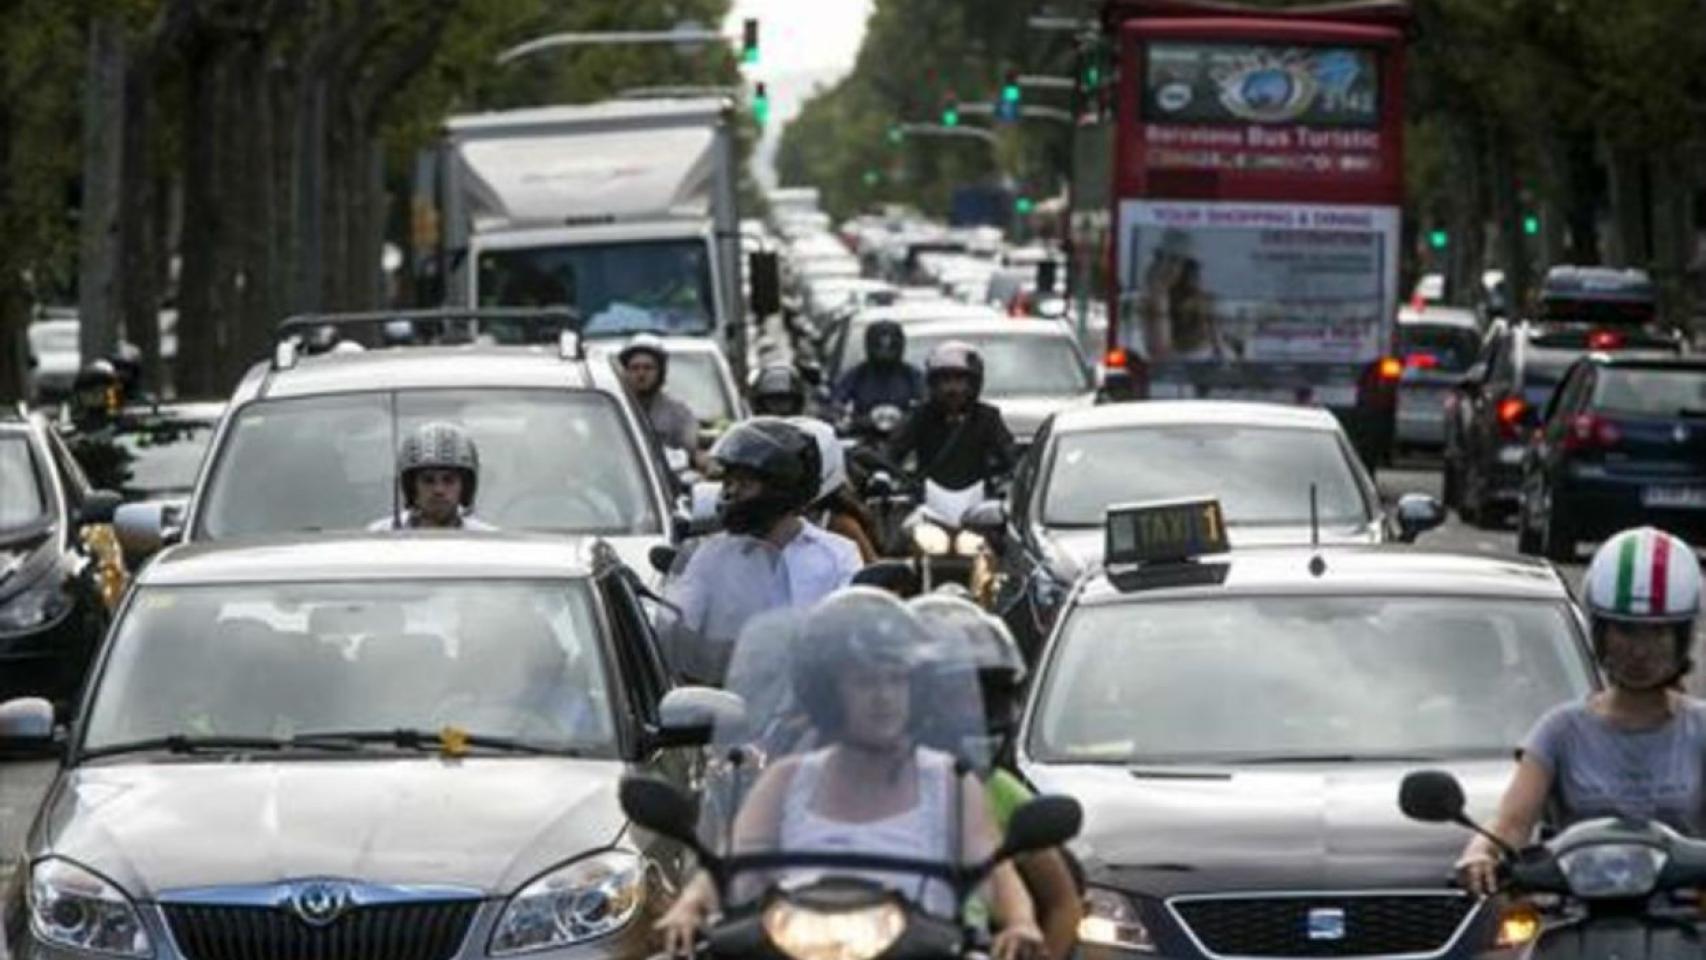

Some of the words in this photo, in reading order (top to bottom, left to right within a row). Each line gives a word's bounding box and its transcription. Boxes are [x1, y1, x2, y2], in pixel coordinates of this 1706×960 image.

[1146, 125, 1242, 144] Barcelona
[1247, 127, 1291, 147] Bus
[1152, 207, 1200, 222] YOUR
[1206, 209, 1293, 224] SHOPPING
